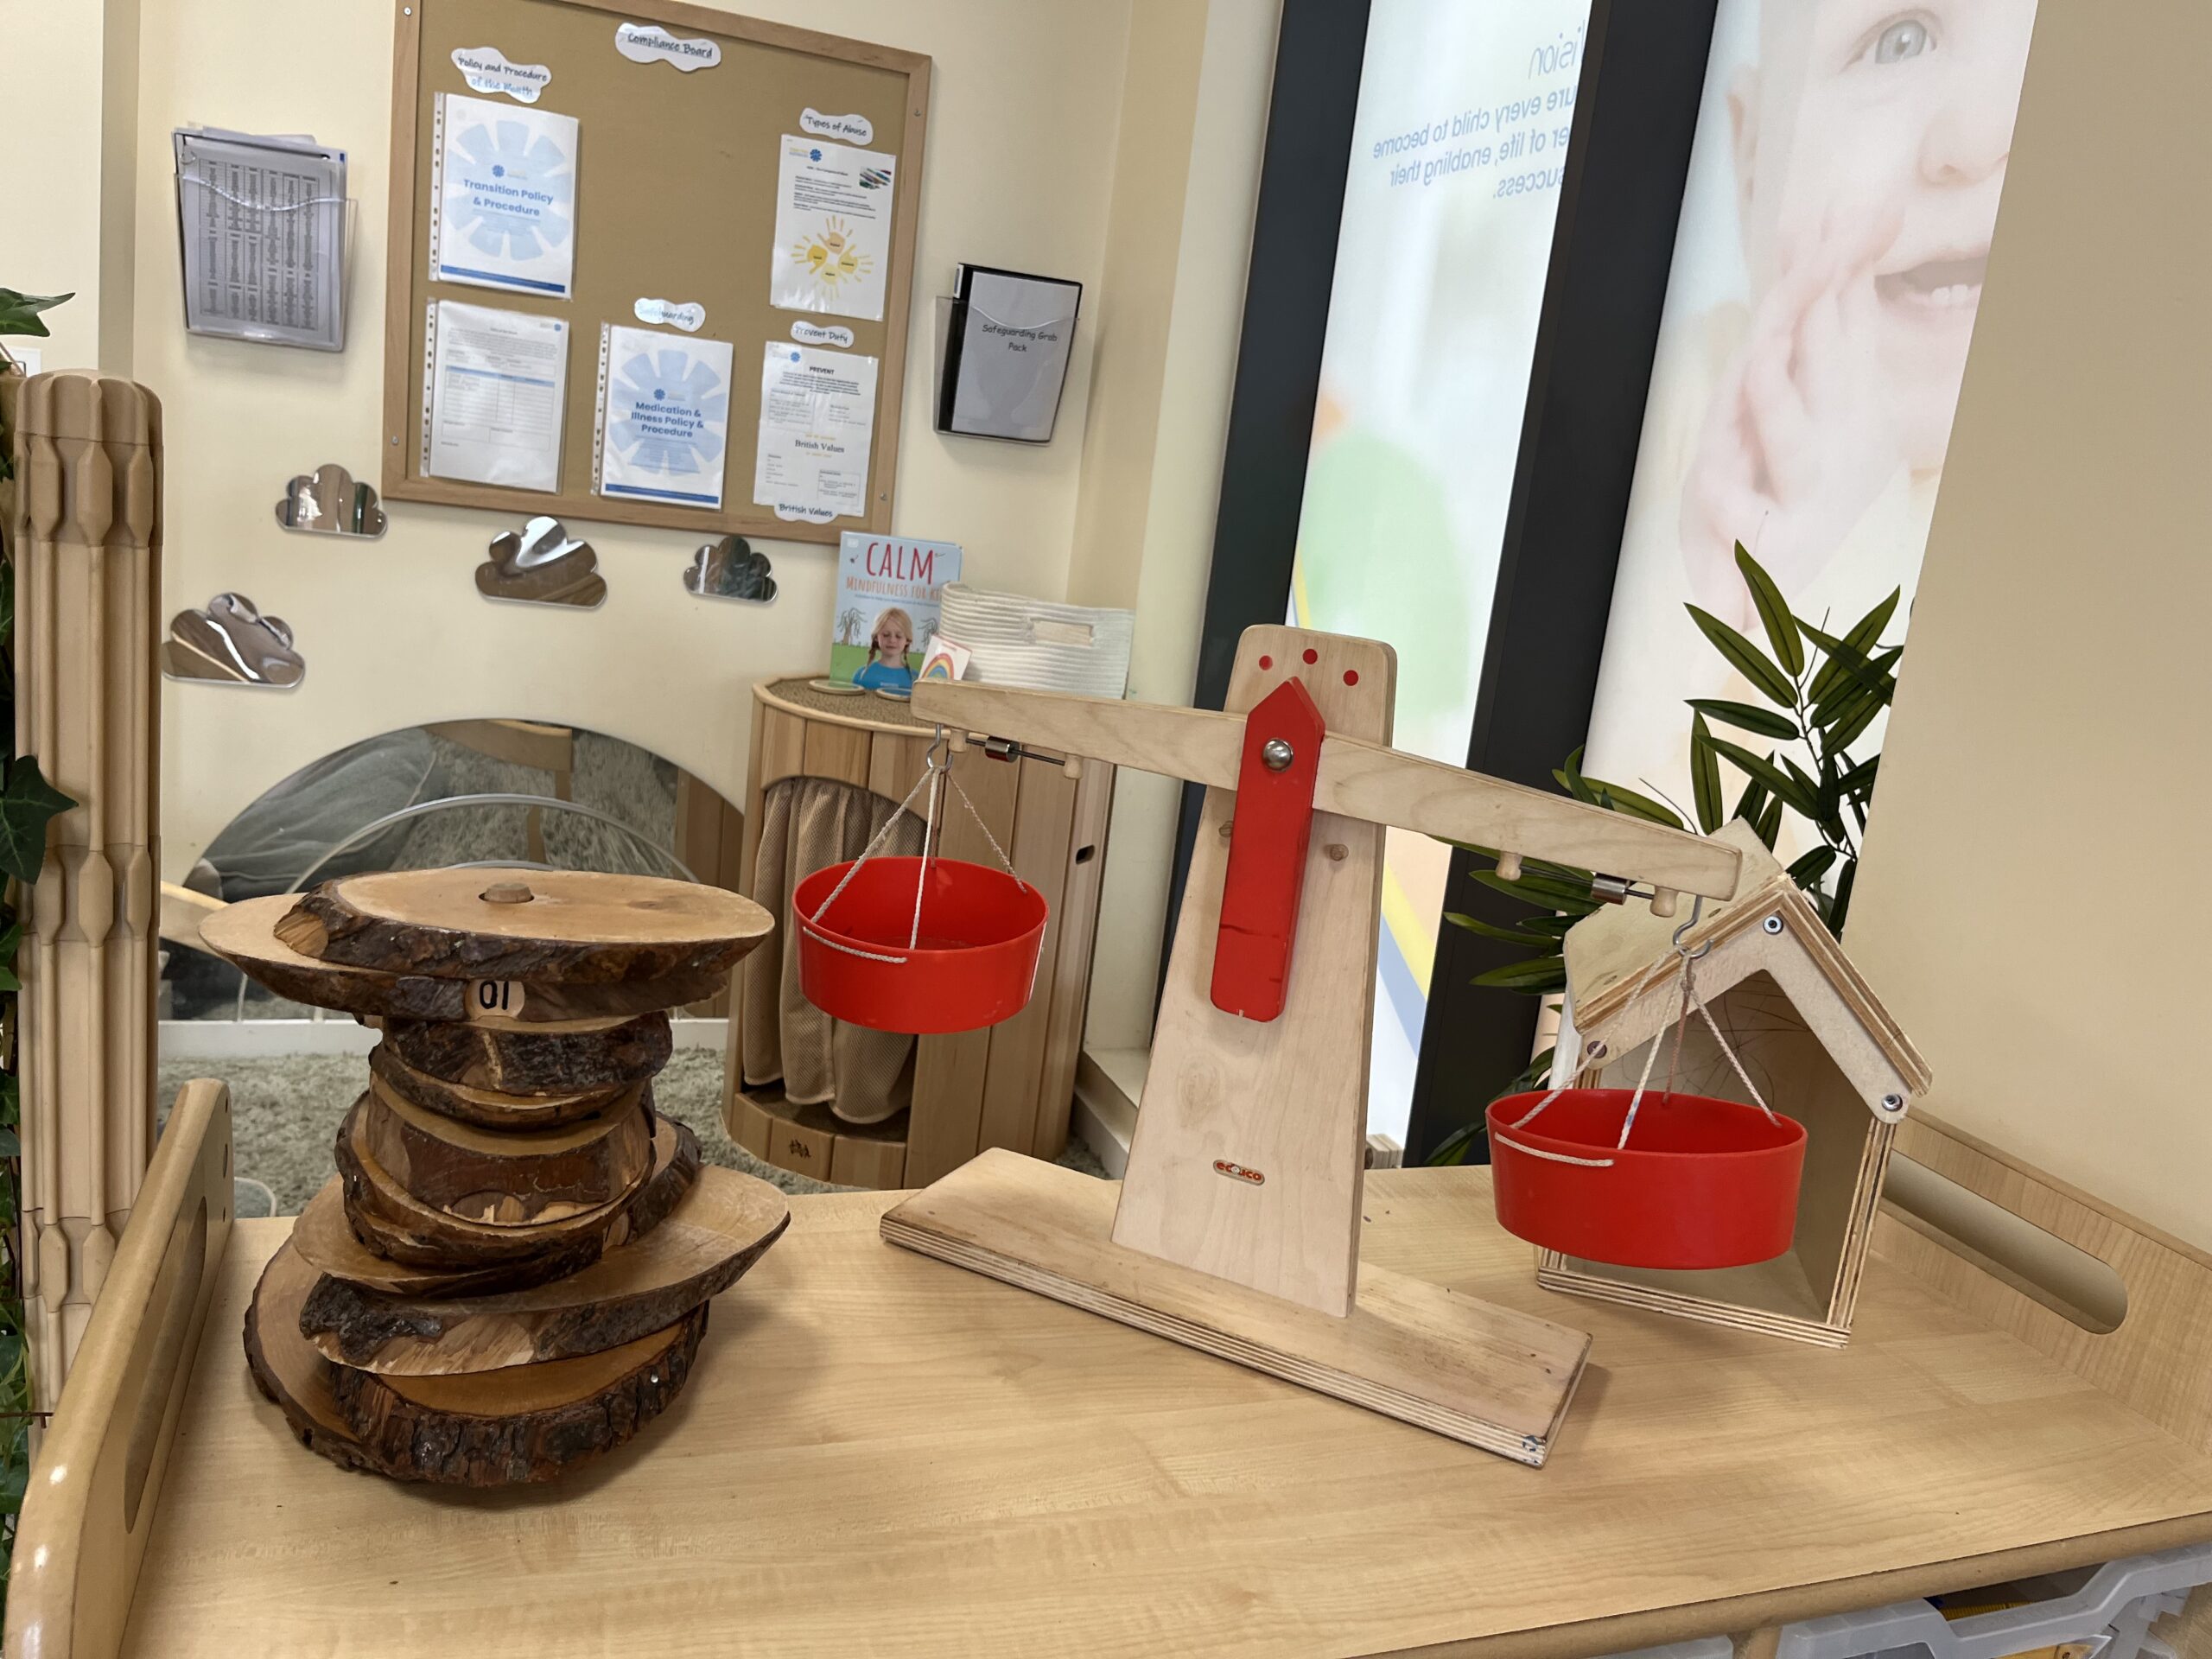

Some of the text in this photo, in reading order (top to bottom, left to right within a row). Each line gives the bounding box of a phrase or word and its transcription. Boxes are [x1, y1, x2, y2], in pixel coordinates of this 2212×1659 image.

[627, 33, 713, 59] Compliance Board
[458, 54, 548, 82] Policy and Procedure
[471, 76, 482, 86] of
[485, 79, 500, 90] the
[806, 116, 867, 137] Types of Abuse
[463, 179, 554, 205] Transition Policy
[473, 196, 540, 216] & Procedure
[829, 331, 849, 343] Duty
[982, 324, 1058, 342] Safeguarding Grab
[1008, 342, 1027, 353] Pack
[810, 365, 835, 375] PREVENT
[636, 402, 702, 418] Medication &
[632, 411, 704, 429] Illness Policy &
[641, 424, 693, 438] Procedure
[795, 439, 845, 454] British Values
[779, 503, 833, 518] British Values
[867, 542, 933, 585] CALM
[846, 576, 908, 598] MINDFULNESS
